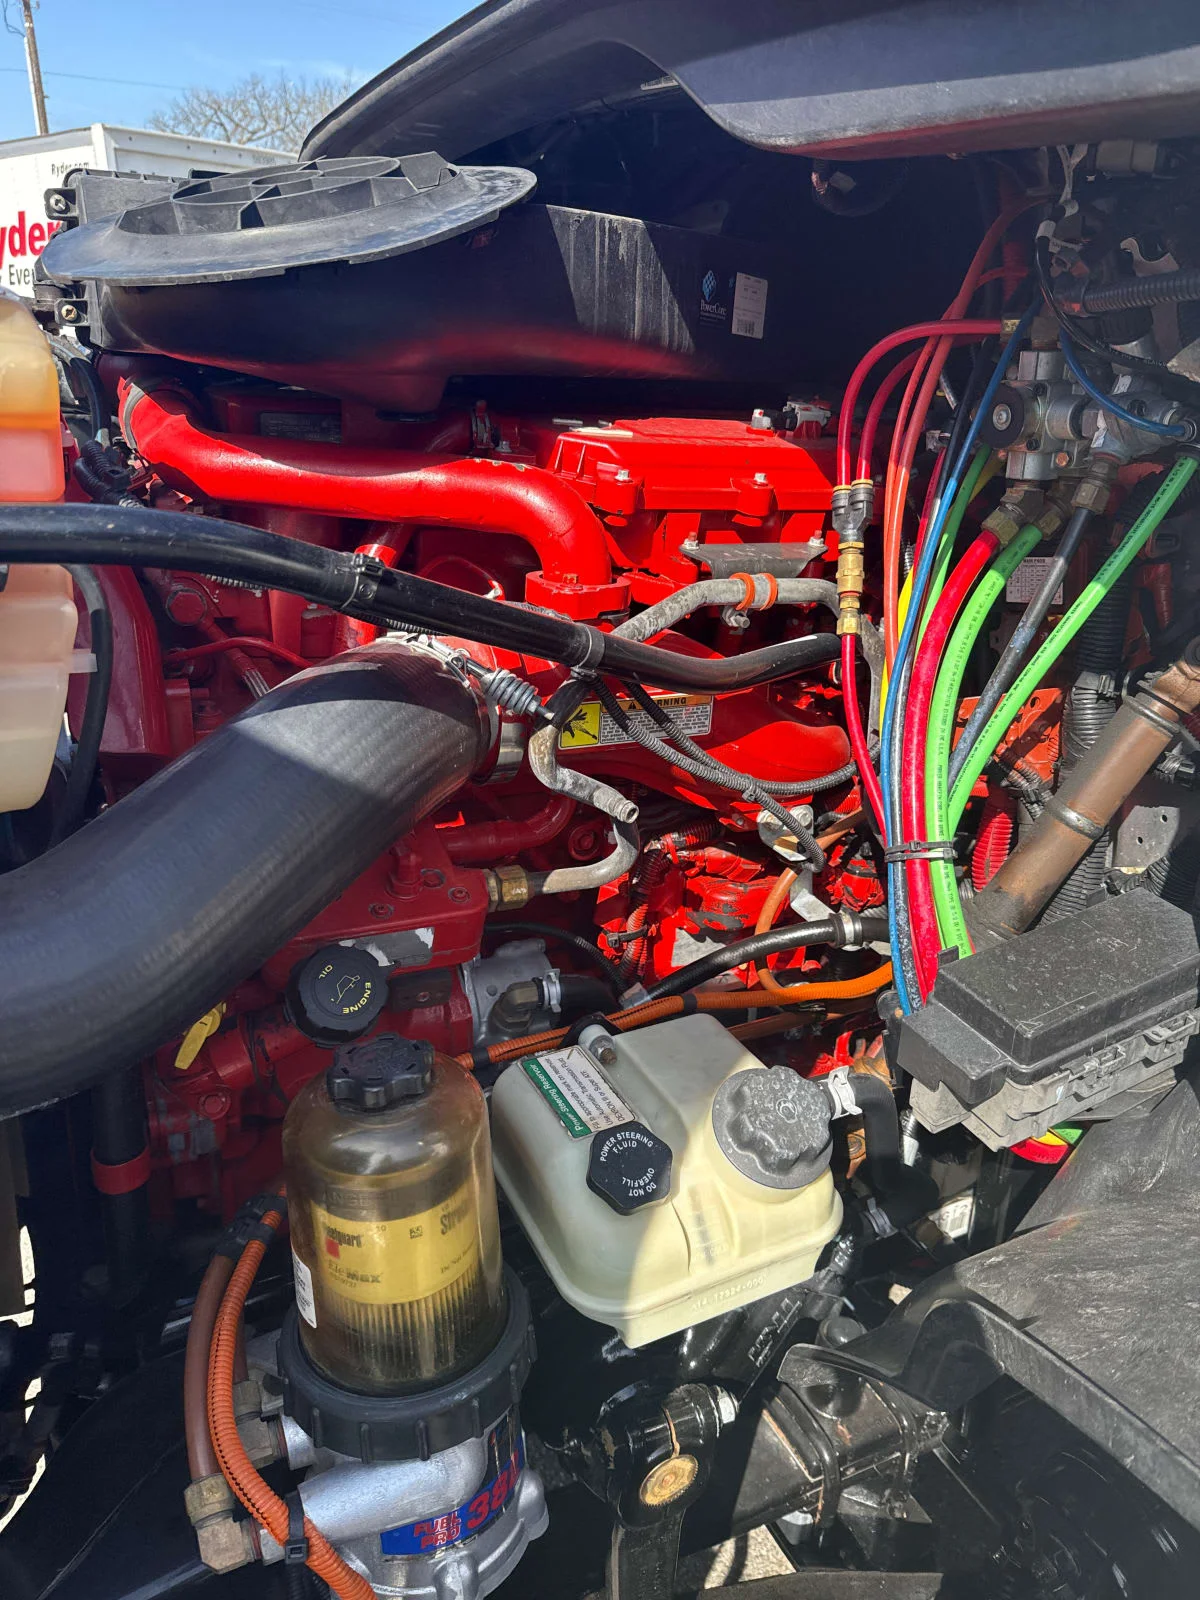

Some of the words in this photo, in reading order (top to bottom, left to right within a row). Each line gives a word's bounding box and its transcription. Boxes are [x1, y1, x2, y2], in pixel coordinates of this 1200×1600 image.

[657, 697, 687, 707] RNING
[319, 964, 333, 980] OIL
[342, 982, 372, 1014] ENGINE
[531, 1064, 552, 1090] Reservoir
[549, 1088, 569, 1113] Steering
[568, 1114, 584, 1132] Power
[600, 1136, 617, 1162] POWER
[616, 1131, 654, 1148] STEERING
[612, 1140, 637, 1154] FLUID
[621, 1167, 655, 1188] OVERFILL
[645, 1181, 657, 1193] DO
[628, 1188, 645, 1197] NOT
[413, 1510, 462, 1537] FUEL
[420, 1525, 461, 1549] PRO
